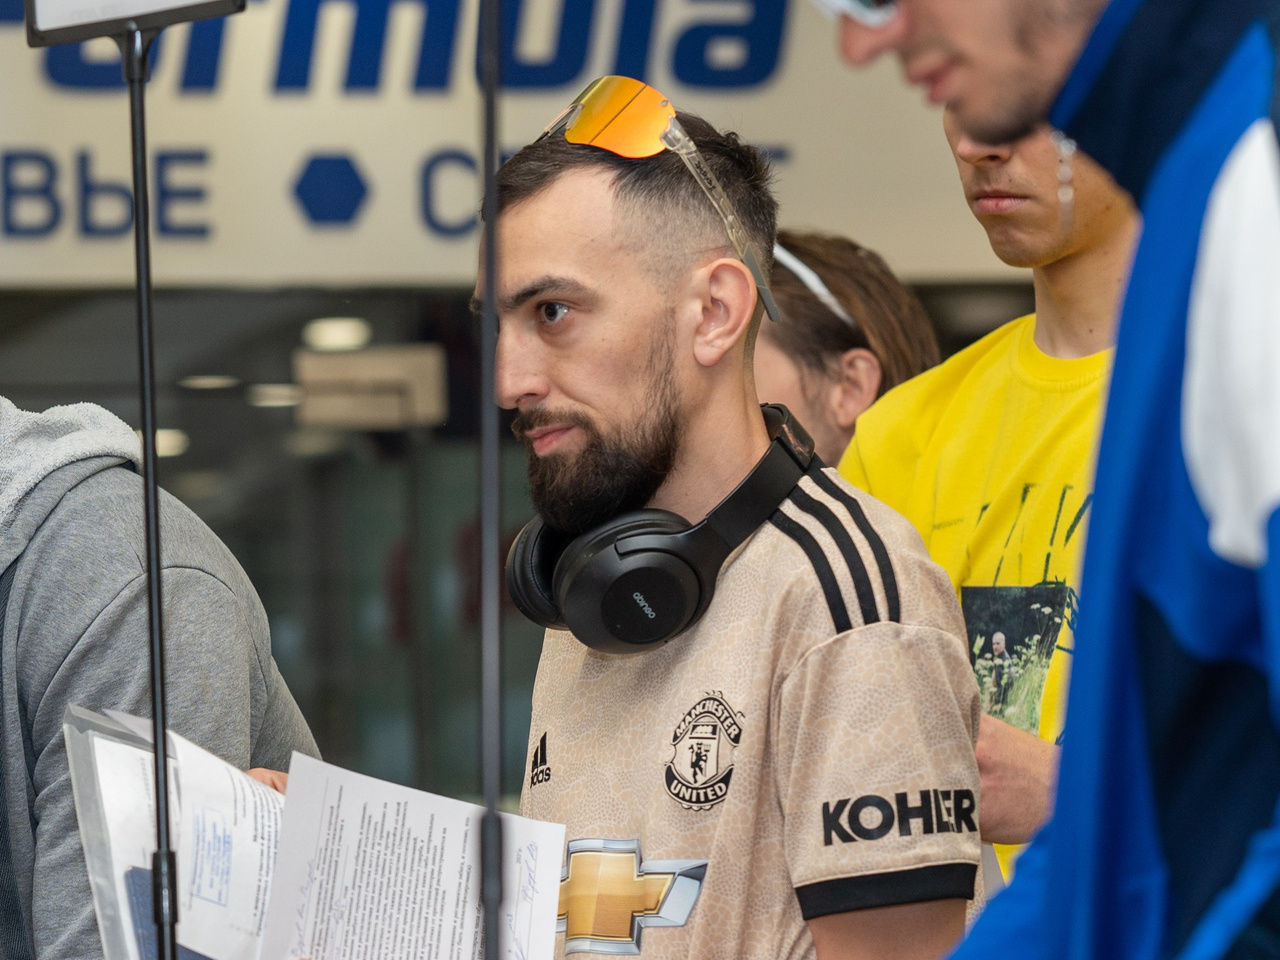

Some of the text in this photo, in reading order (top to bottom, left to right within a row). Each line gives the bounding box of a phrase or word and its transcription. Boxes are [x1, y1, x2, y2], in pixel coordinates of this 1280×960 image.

[676, 700, 740, 739] MANCHESTER
[670, 780, 727, 802] UNITED
[822, 788, 978, 847] KOHLER
